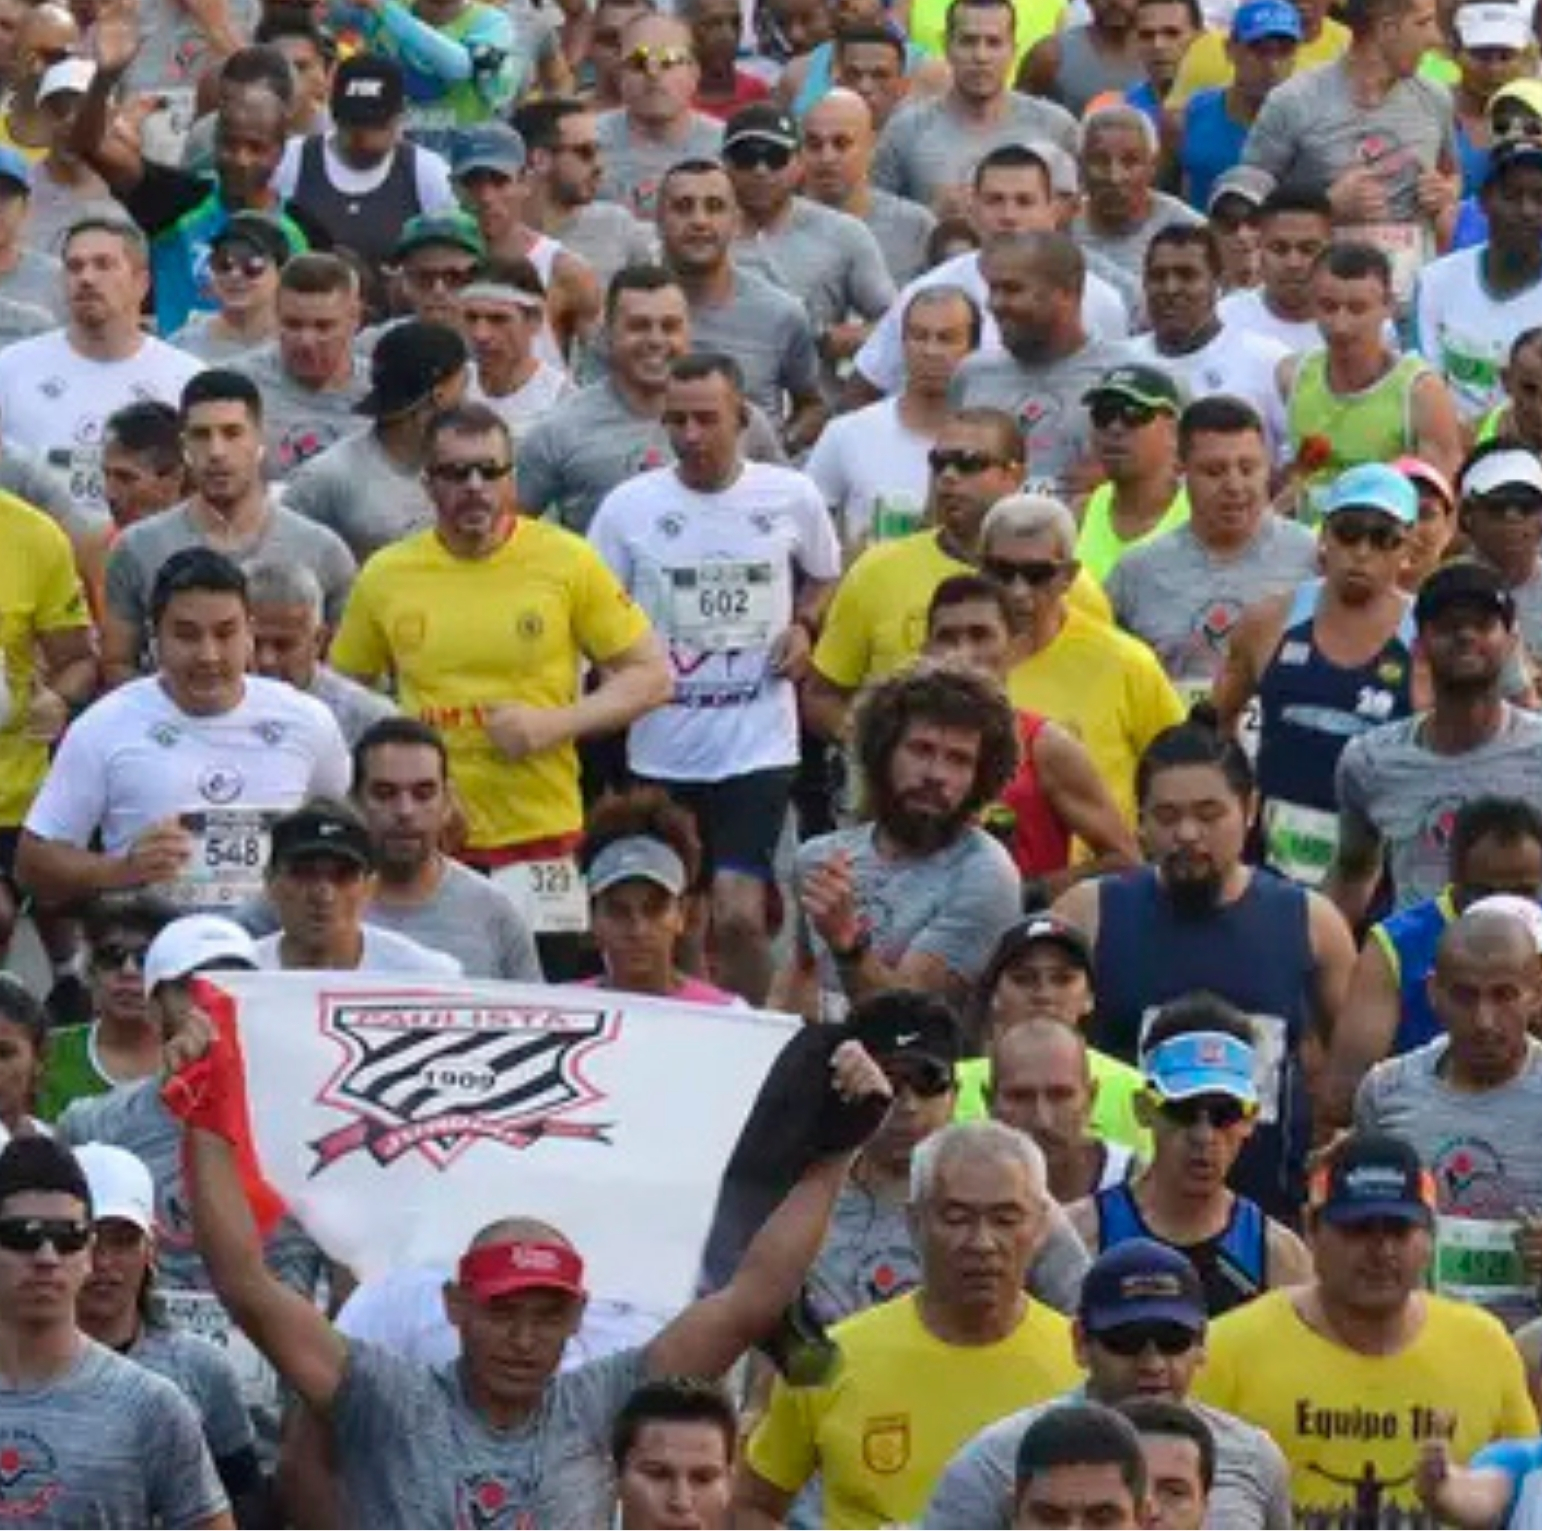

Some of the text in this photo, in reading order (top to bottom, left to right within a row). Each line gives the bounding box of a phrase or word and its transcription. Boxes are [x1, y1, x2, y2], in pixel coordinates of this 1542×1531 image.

[698, 588, 749, 617] 602
[205, 838, 259, 868] 548
[423, 1070, 495, 1091] 1909
